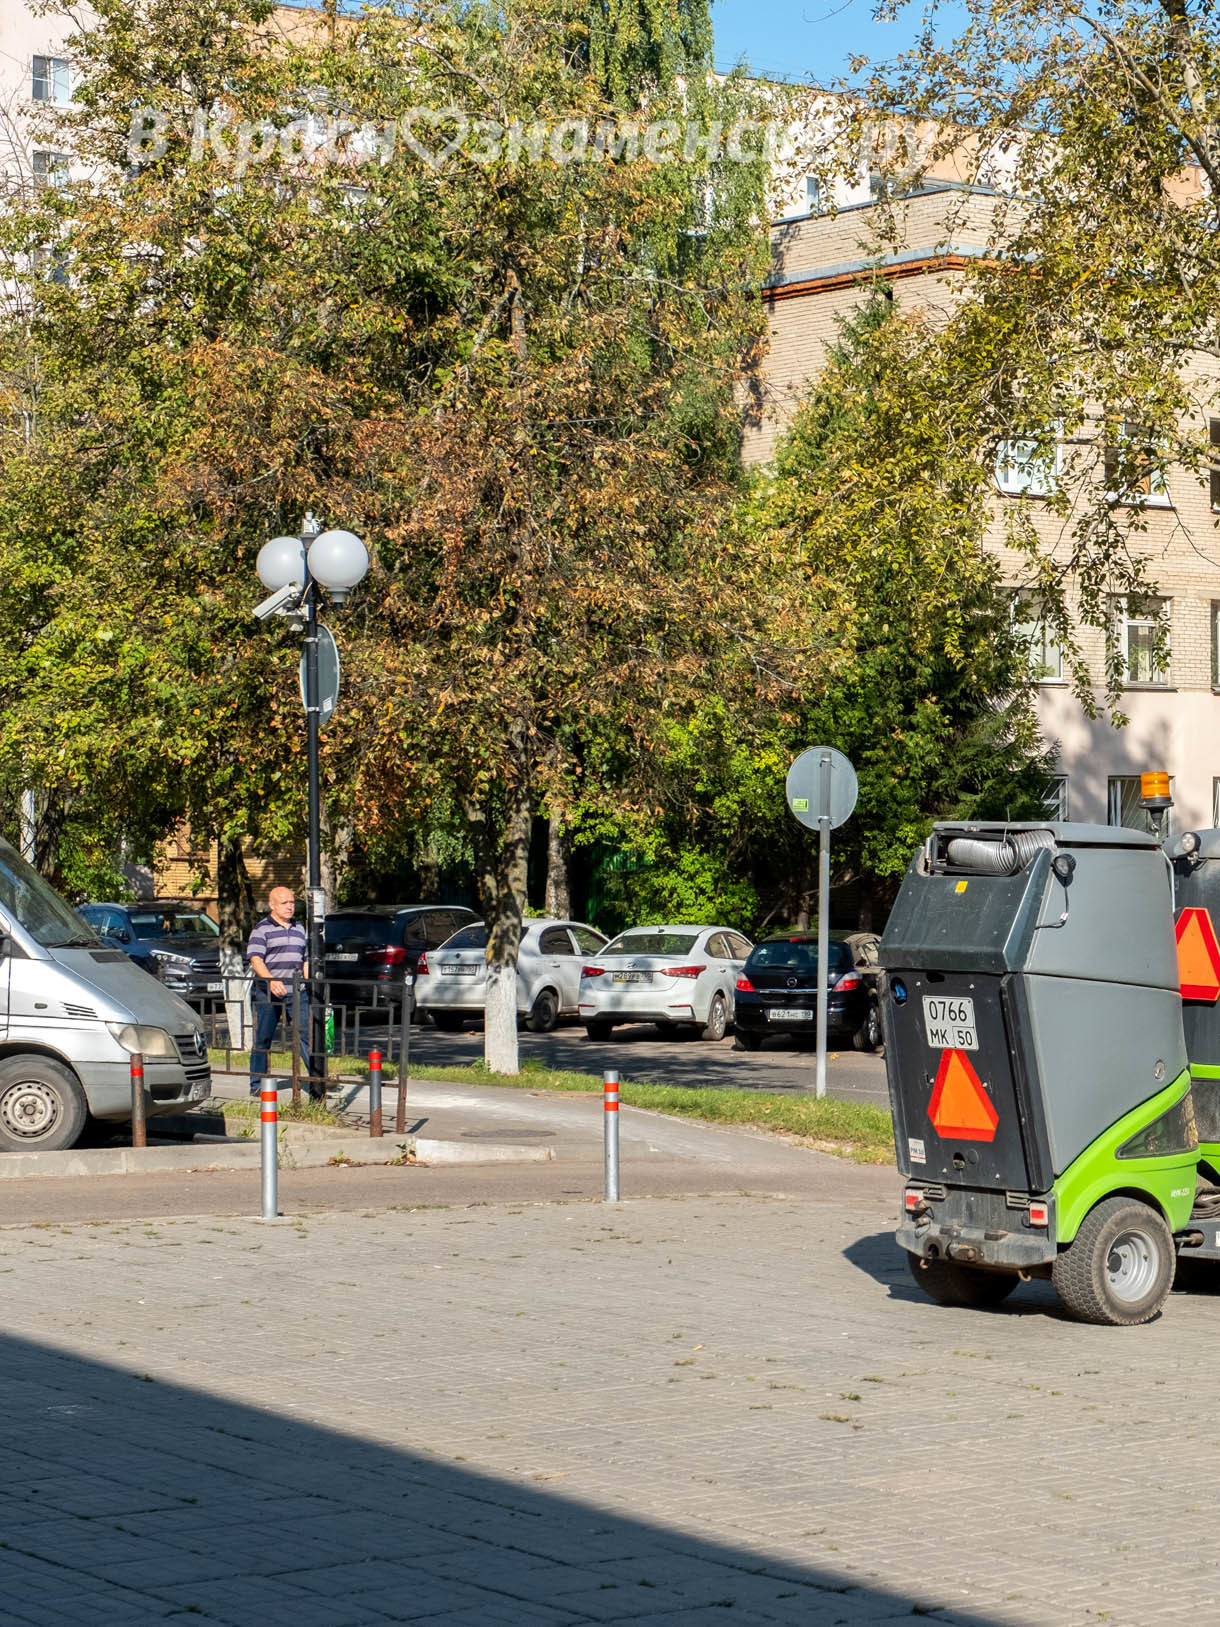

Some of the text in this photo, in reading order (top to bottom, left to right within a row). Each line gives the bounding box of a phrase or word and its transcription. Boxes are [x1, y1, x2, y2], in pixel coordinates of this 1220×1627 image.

[929, 1000, 967, 1022] 0766
[929, 1028, 973, 1046] МК 50
